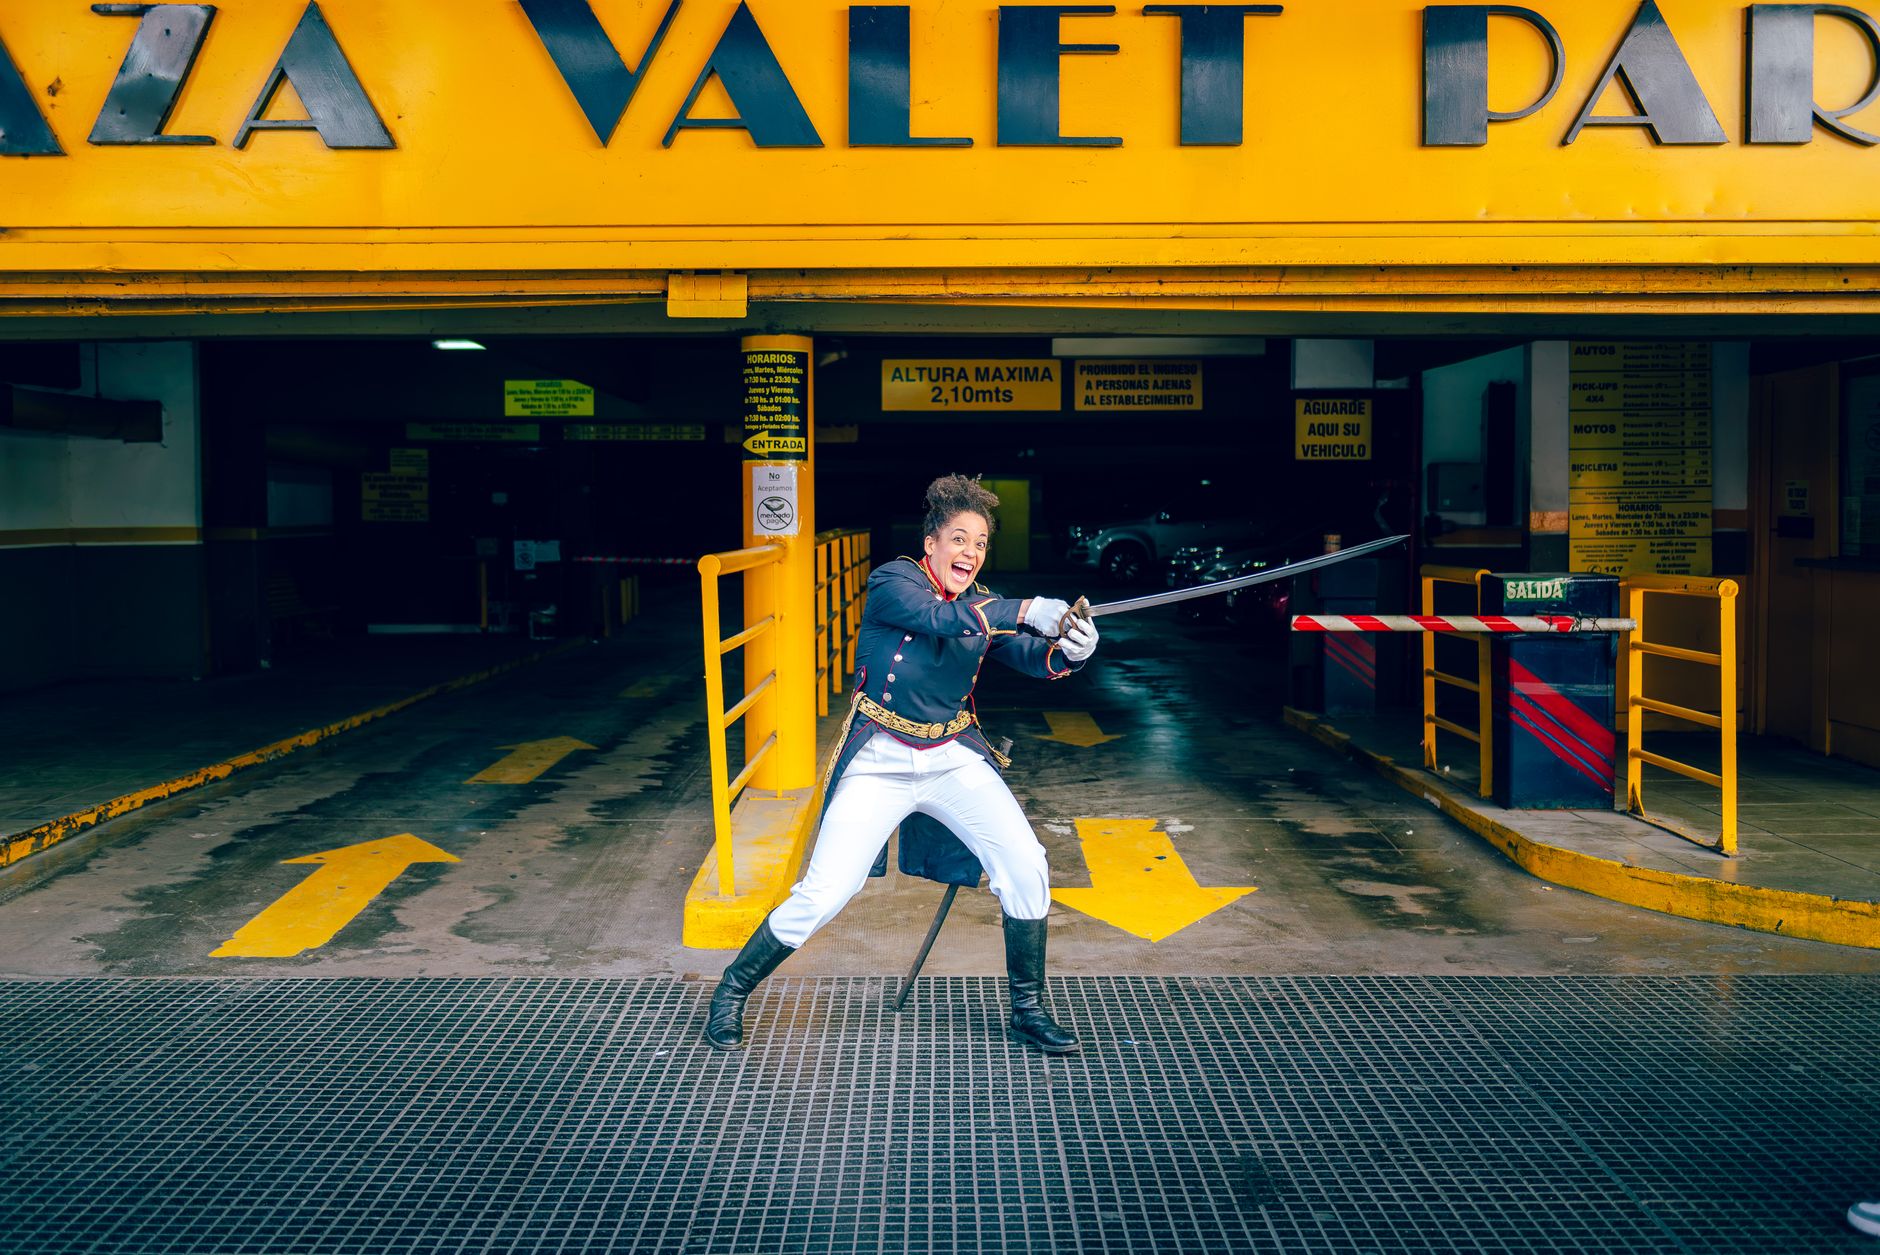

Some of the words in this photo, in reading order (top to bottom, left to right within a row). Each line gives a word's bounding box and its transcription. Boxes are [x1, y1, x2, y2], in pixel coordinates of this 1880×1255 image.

[517, 0, 1284, 149] VALET
[1574, 345, 1616, 356] AUTOS
[746, 354, 796, 364] HORARIOS:
[891, 366, 970, 382] ALTURA
[974, 366, 1054, 382] MAXIMA
[1079, 364, 1136, 376] PROHIBIDO
[1138, 364, 1150, 375] EL
[1152, 364, 1198, 375] INGRESO
[1085, 380, 1093, 390] A
[1095, 379, 1150, 390] PERSONAS
[1152, 379, 1192, 390] AJENAS
[930, 386, 1014, 406] 2,10mts
[1084, 395, 1097, 406] AL
[1099, 394, 1194, 406] ESTABLECIMIENTO
[1303, 401, 1366, 416] AGUARDE
[1307, 422, 1340, 438] AQUI
[1342, 422, 1361, 437] SU
[1573, 424, 1616, 434] MOTOS
[752, 439, 803, 449] ENTRADA
[1301, 444, 1366, 458] VEHICULO
[1571, 463, 1618, 472] BICICLETAS
[768, 472, 780, 480] No
[1506, 580, 1563, 599] SALIDA
